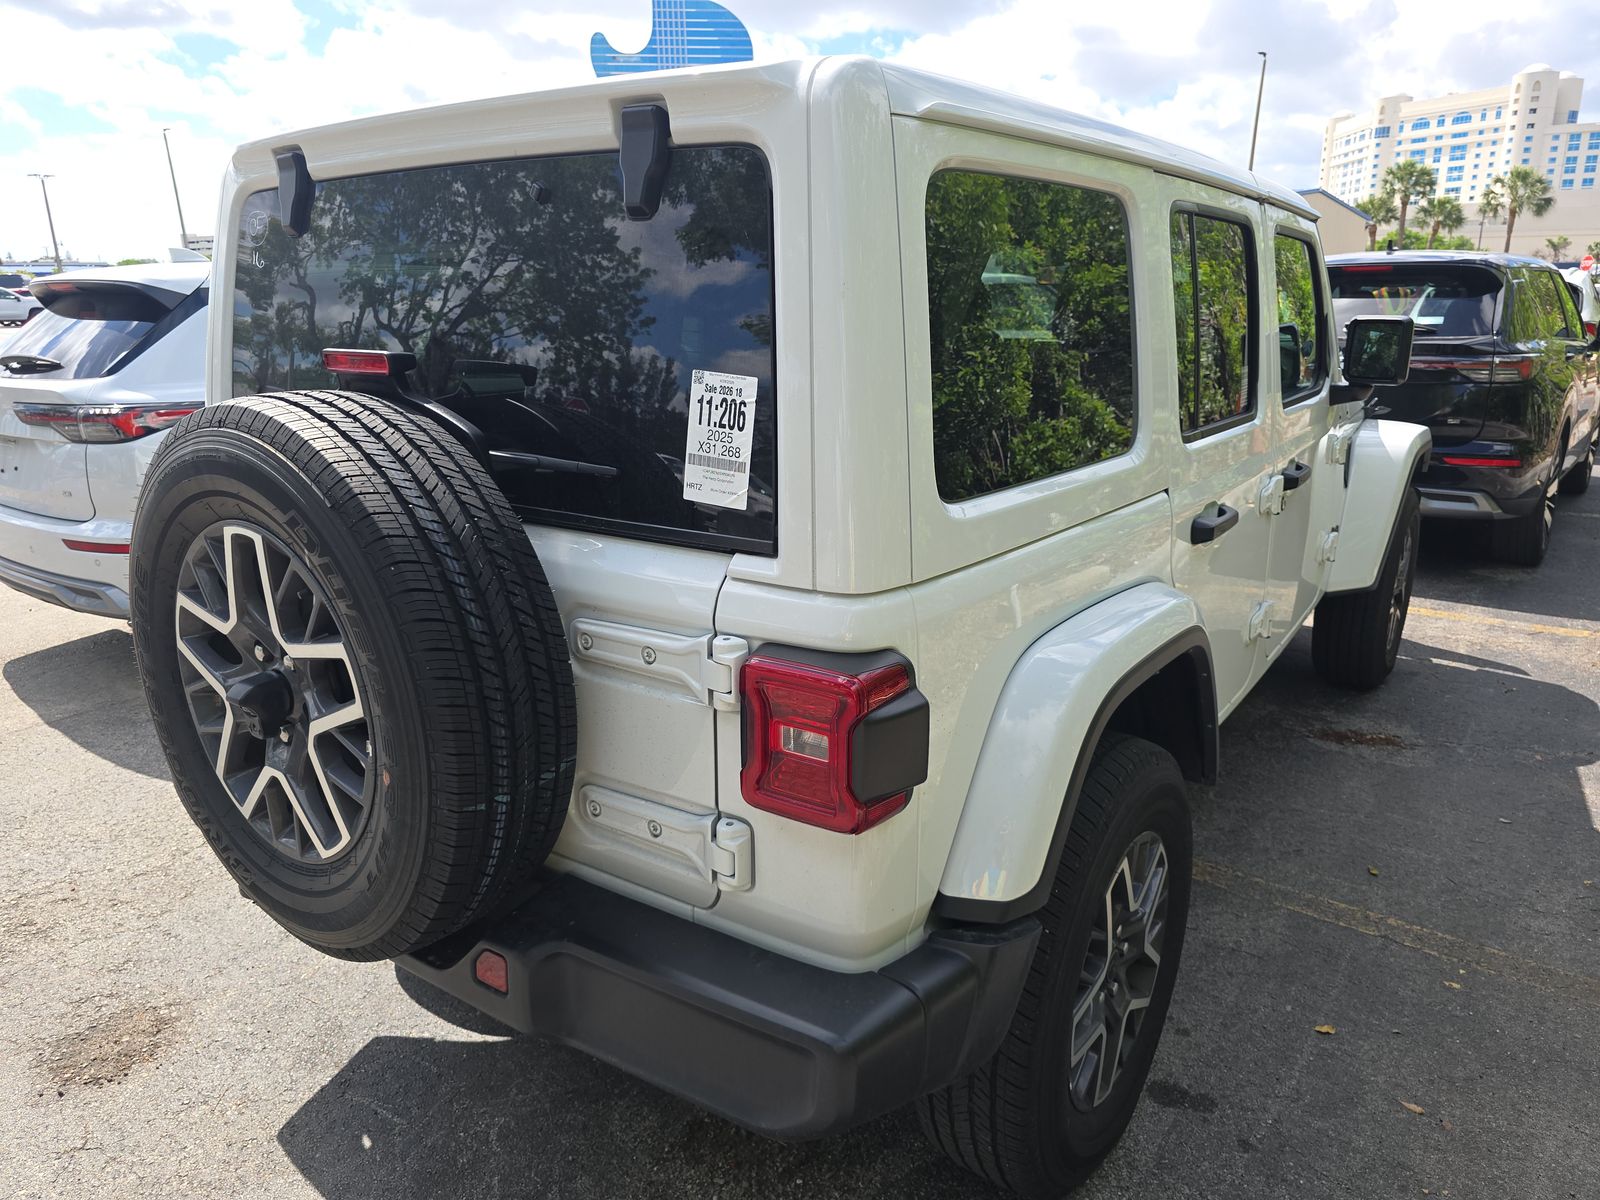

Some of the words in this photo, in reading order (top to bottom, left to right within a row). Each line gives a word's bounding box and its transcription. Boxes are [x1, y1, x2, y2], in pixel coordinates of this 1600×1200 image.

[704, 383, 717, 394] Sale
[719, 385, 734, 397] 2026
[735, 387, 743, 398] 18
[697, 394, 747, 432] 11:206
[707, 429, 733, 444] 2025
[697, 440, 741, 458] X31,268
[686, 482, 703, 491] HRTZ
